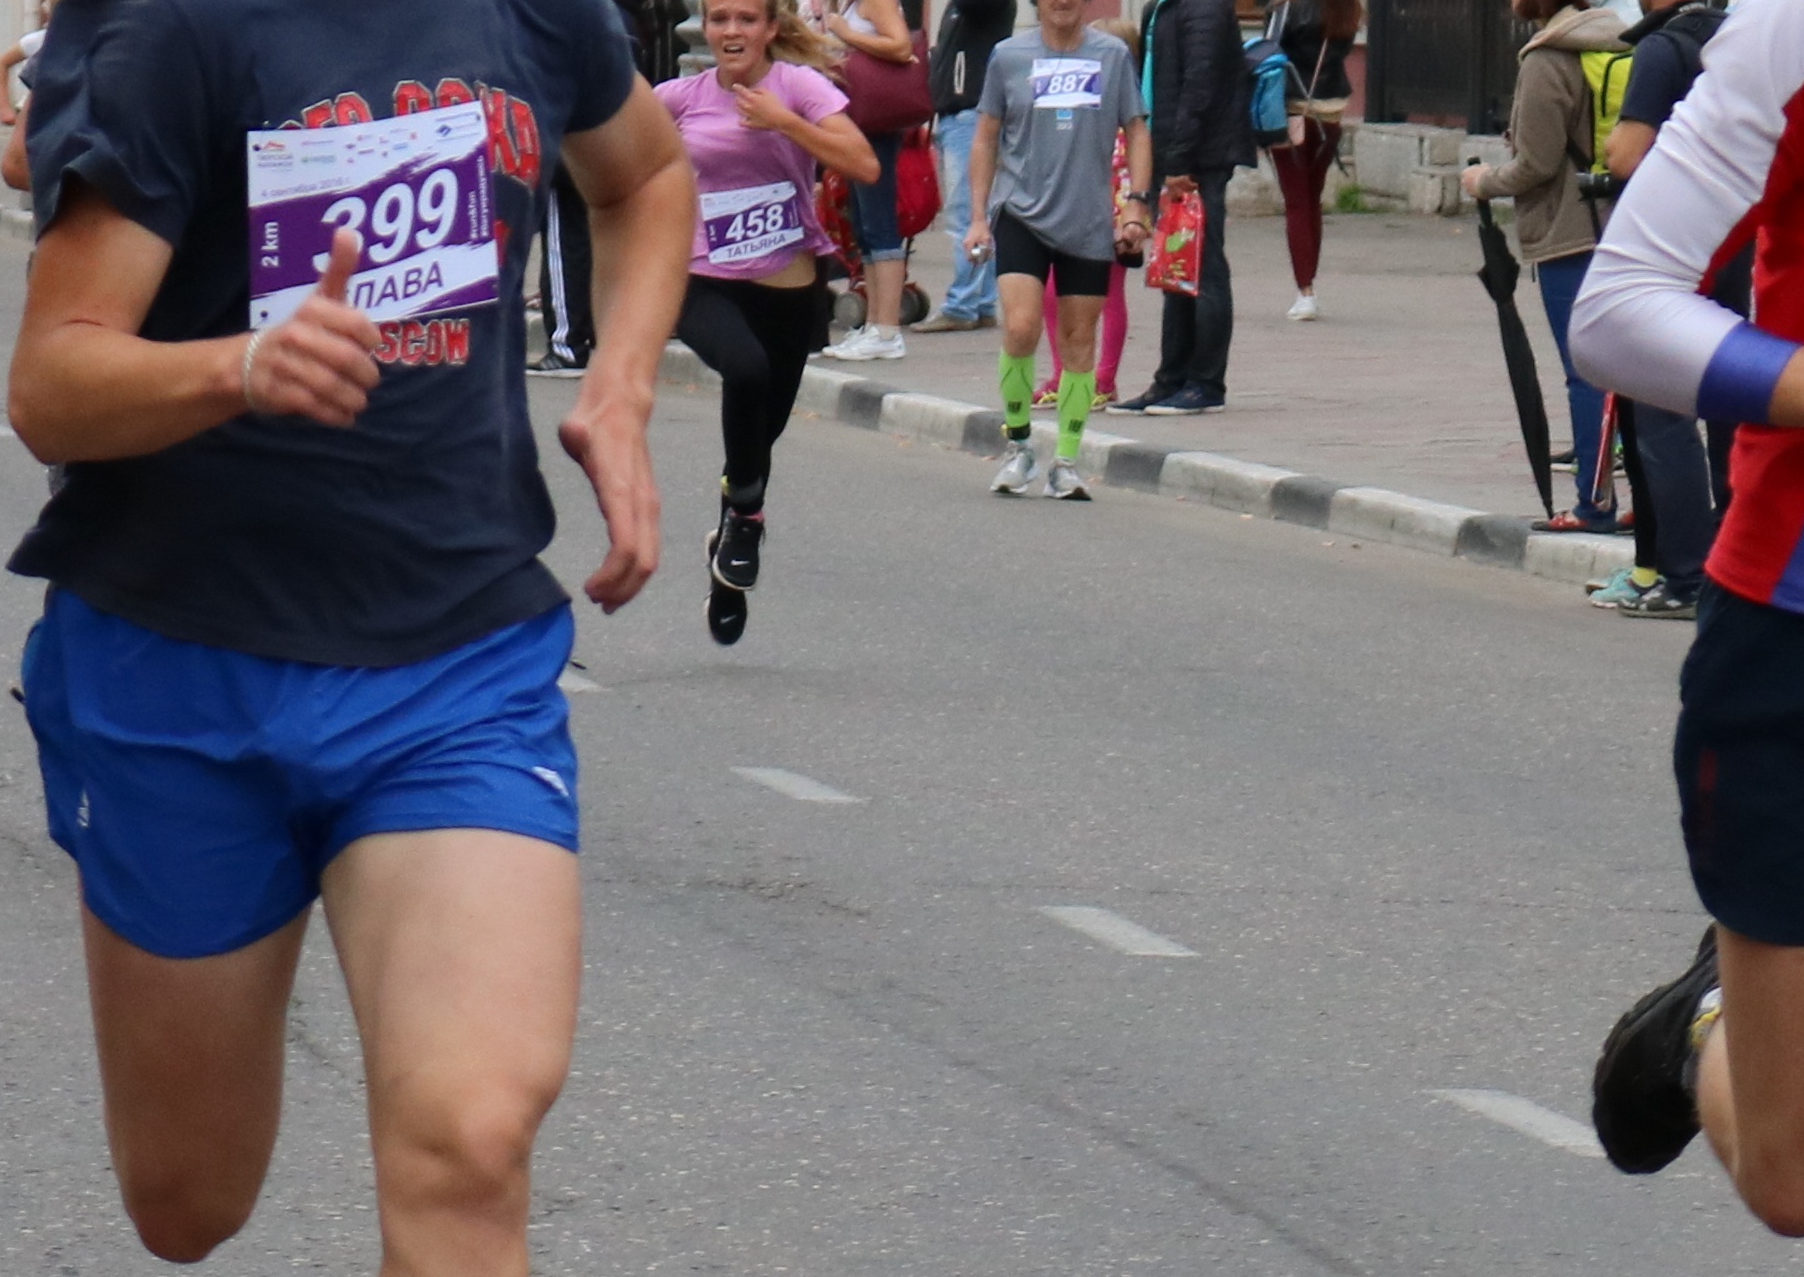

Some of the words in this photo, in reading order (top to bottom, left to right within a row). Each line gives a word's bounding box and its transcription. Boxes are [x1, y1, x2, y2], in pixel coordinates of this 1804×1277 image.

[1047, 74, 1092, 94] 887
[261, 221, 280, 251] km
[312, 168, 459, 274] 399
[725, 204, 784, 241] 458
[261, 255, 280, 268] 2
[726, 233, 786, 258] ТАТЬЯНА
[347, 260, 444, 310] ЛАВА
[371, 319, 471, 367] SCOW
